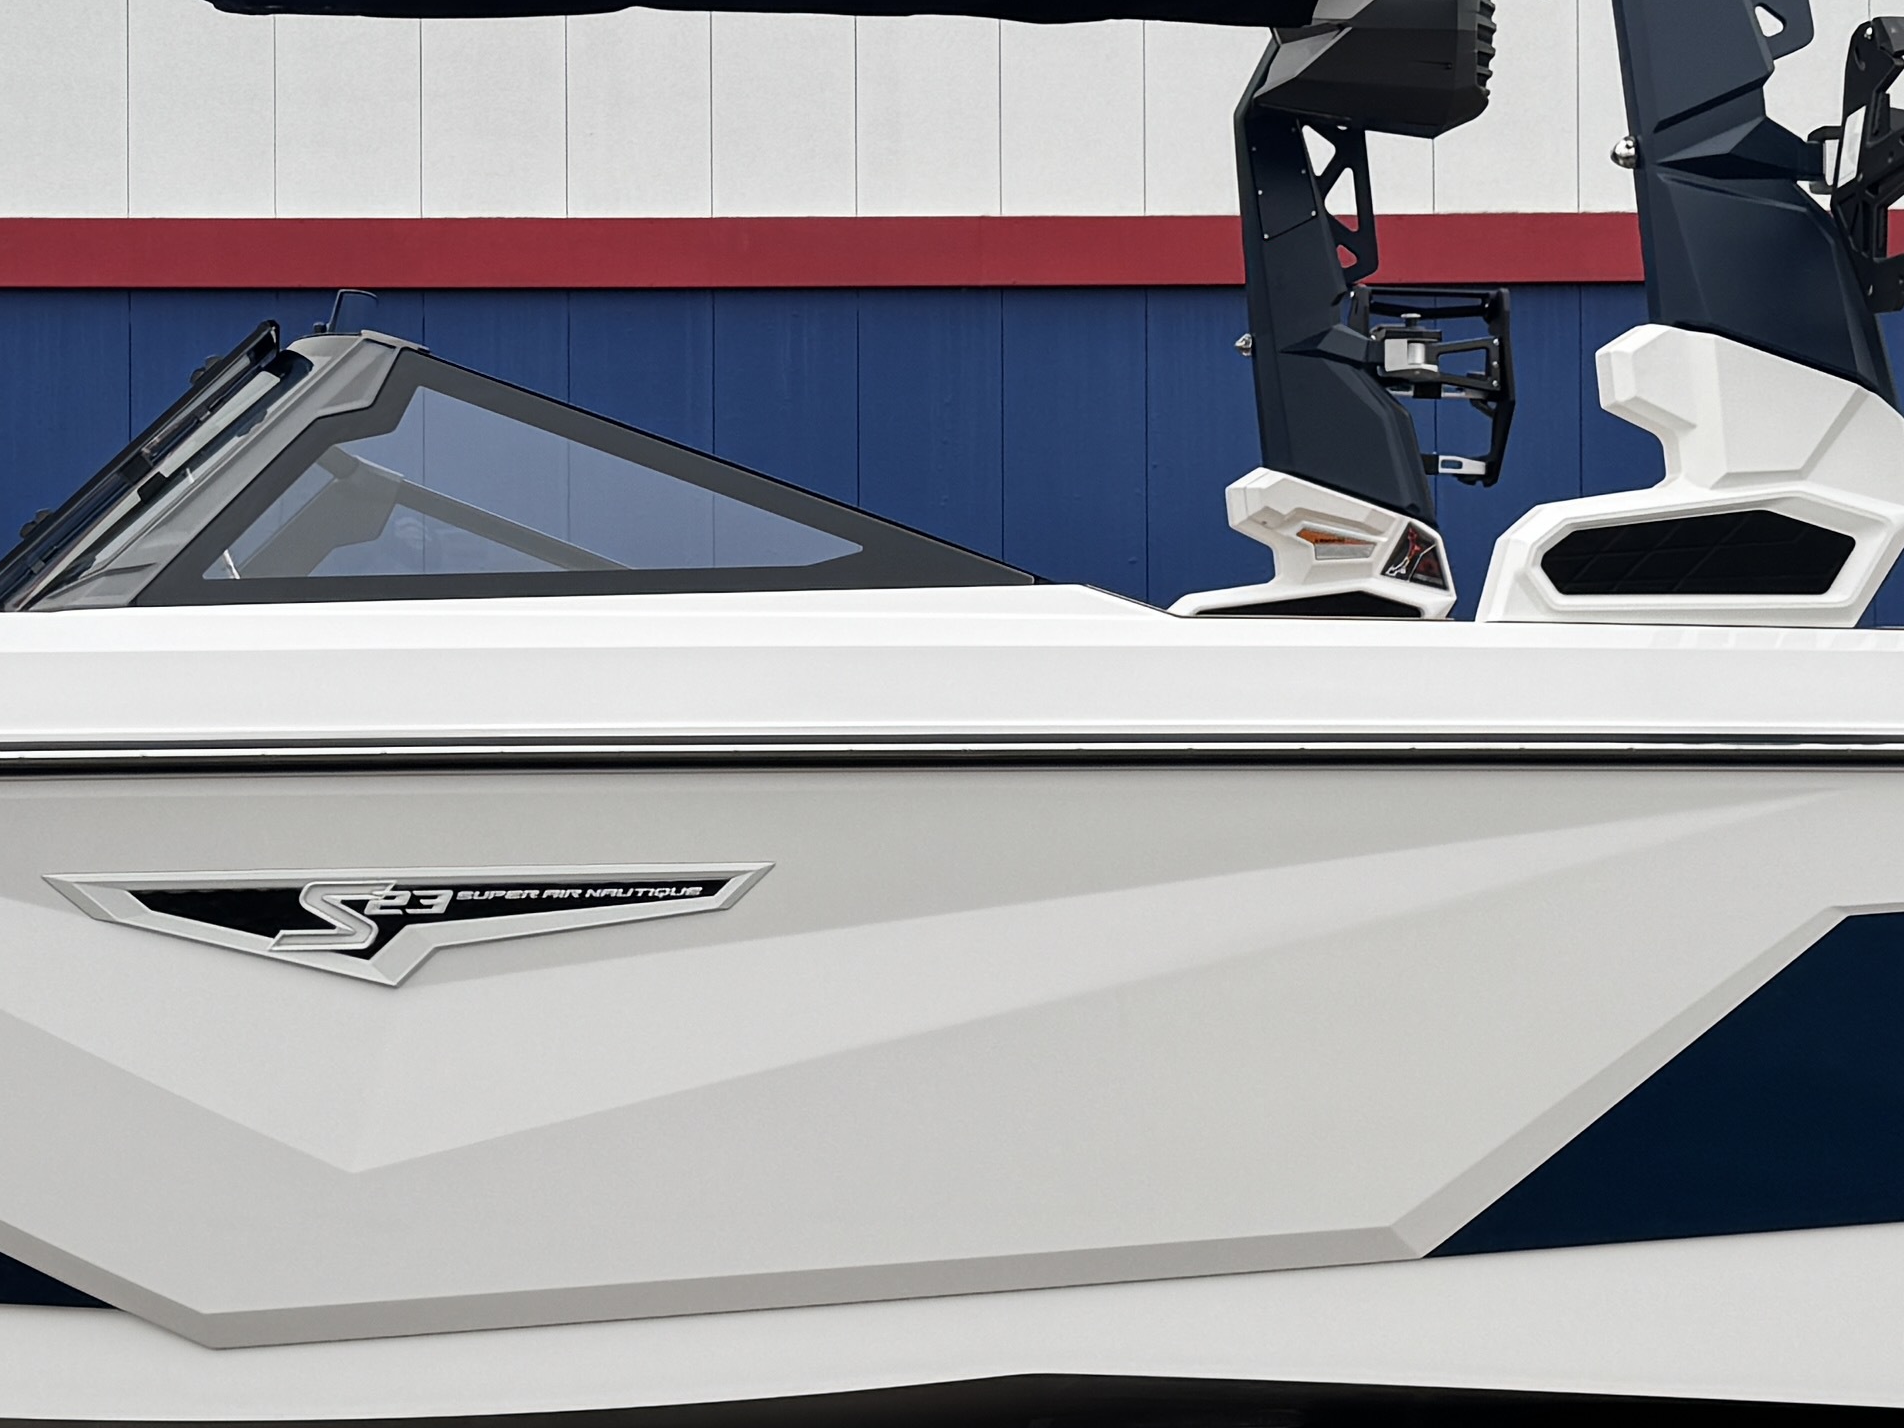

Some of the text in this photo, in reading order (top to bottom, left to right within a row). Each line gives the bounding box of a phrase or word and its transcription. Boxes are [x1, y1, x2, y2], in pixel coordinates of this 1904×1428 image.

[456, 889, 540, 900] SUPER
[542, 889, 583, 899] AIR
[584, 886, 704, 899] NAUTIQUE
